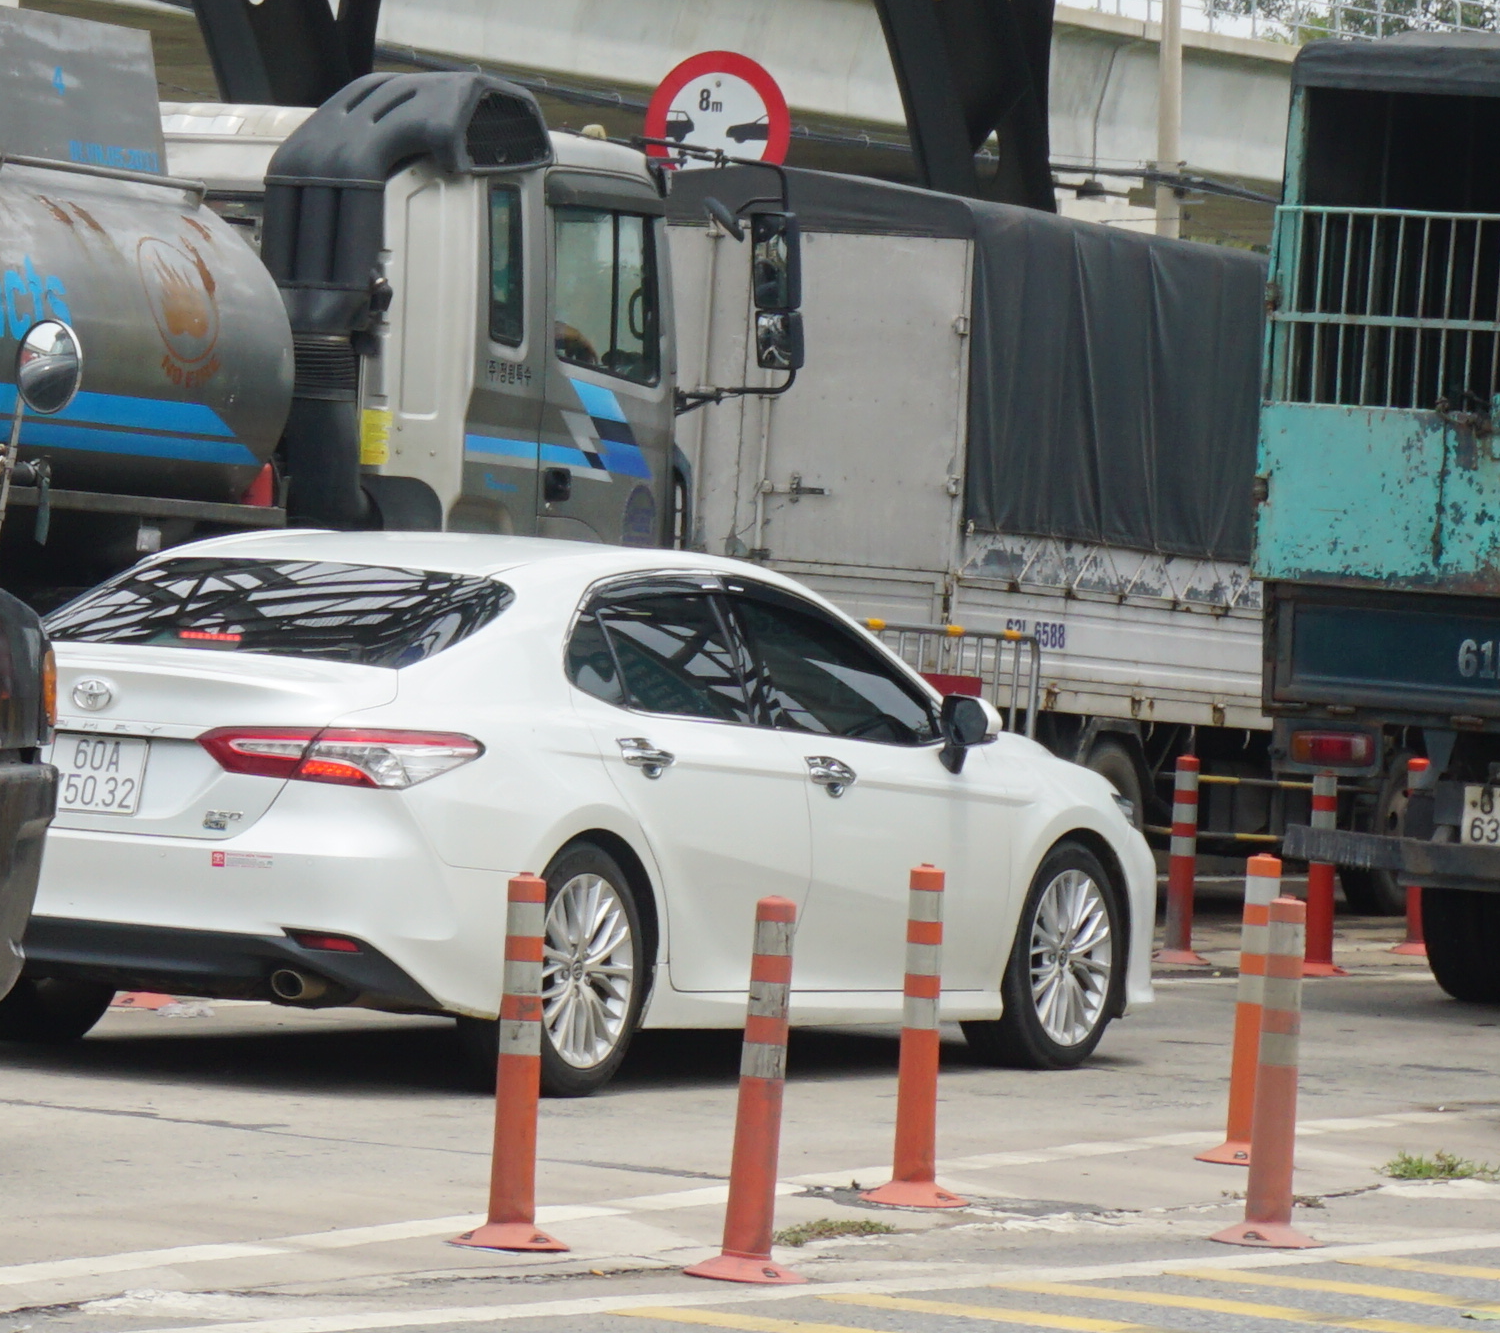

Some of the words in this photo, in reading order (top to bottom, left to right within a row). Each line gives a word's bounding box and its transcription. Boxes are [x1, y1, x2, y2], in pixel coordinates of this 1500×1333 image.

[51, 65, 67, 96] 4
[698, 88, 723, 113] 8m
[73, 738, 121, 773] 60A
